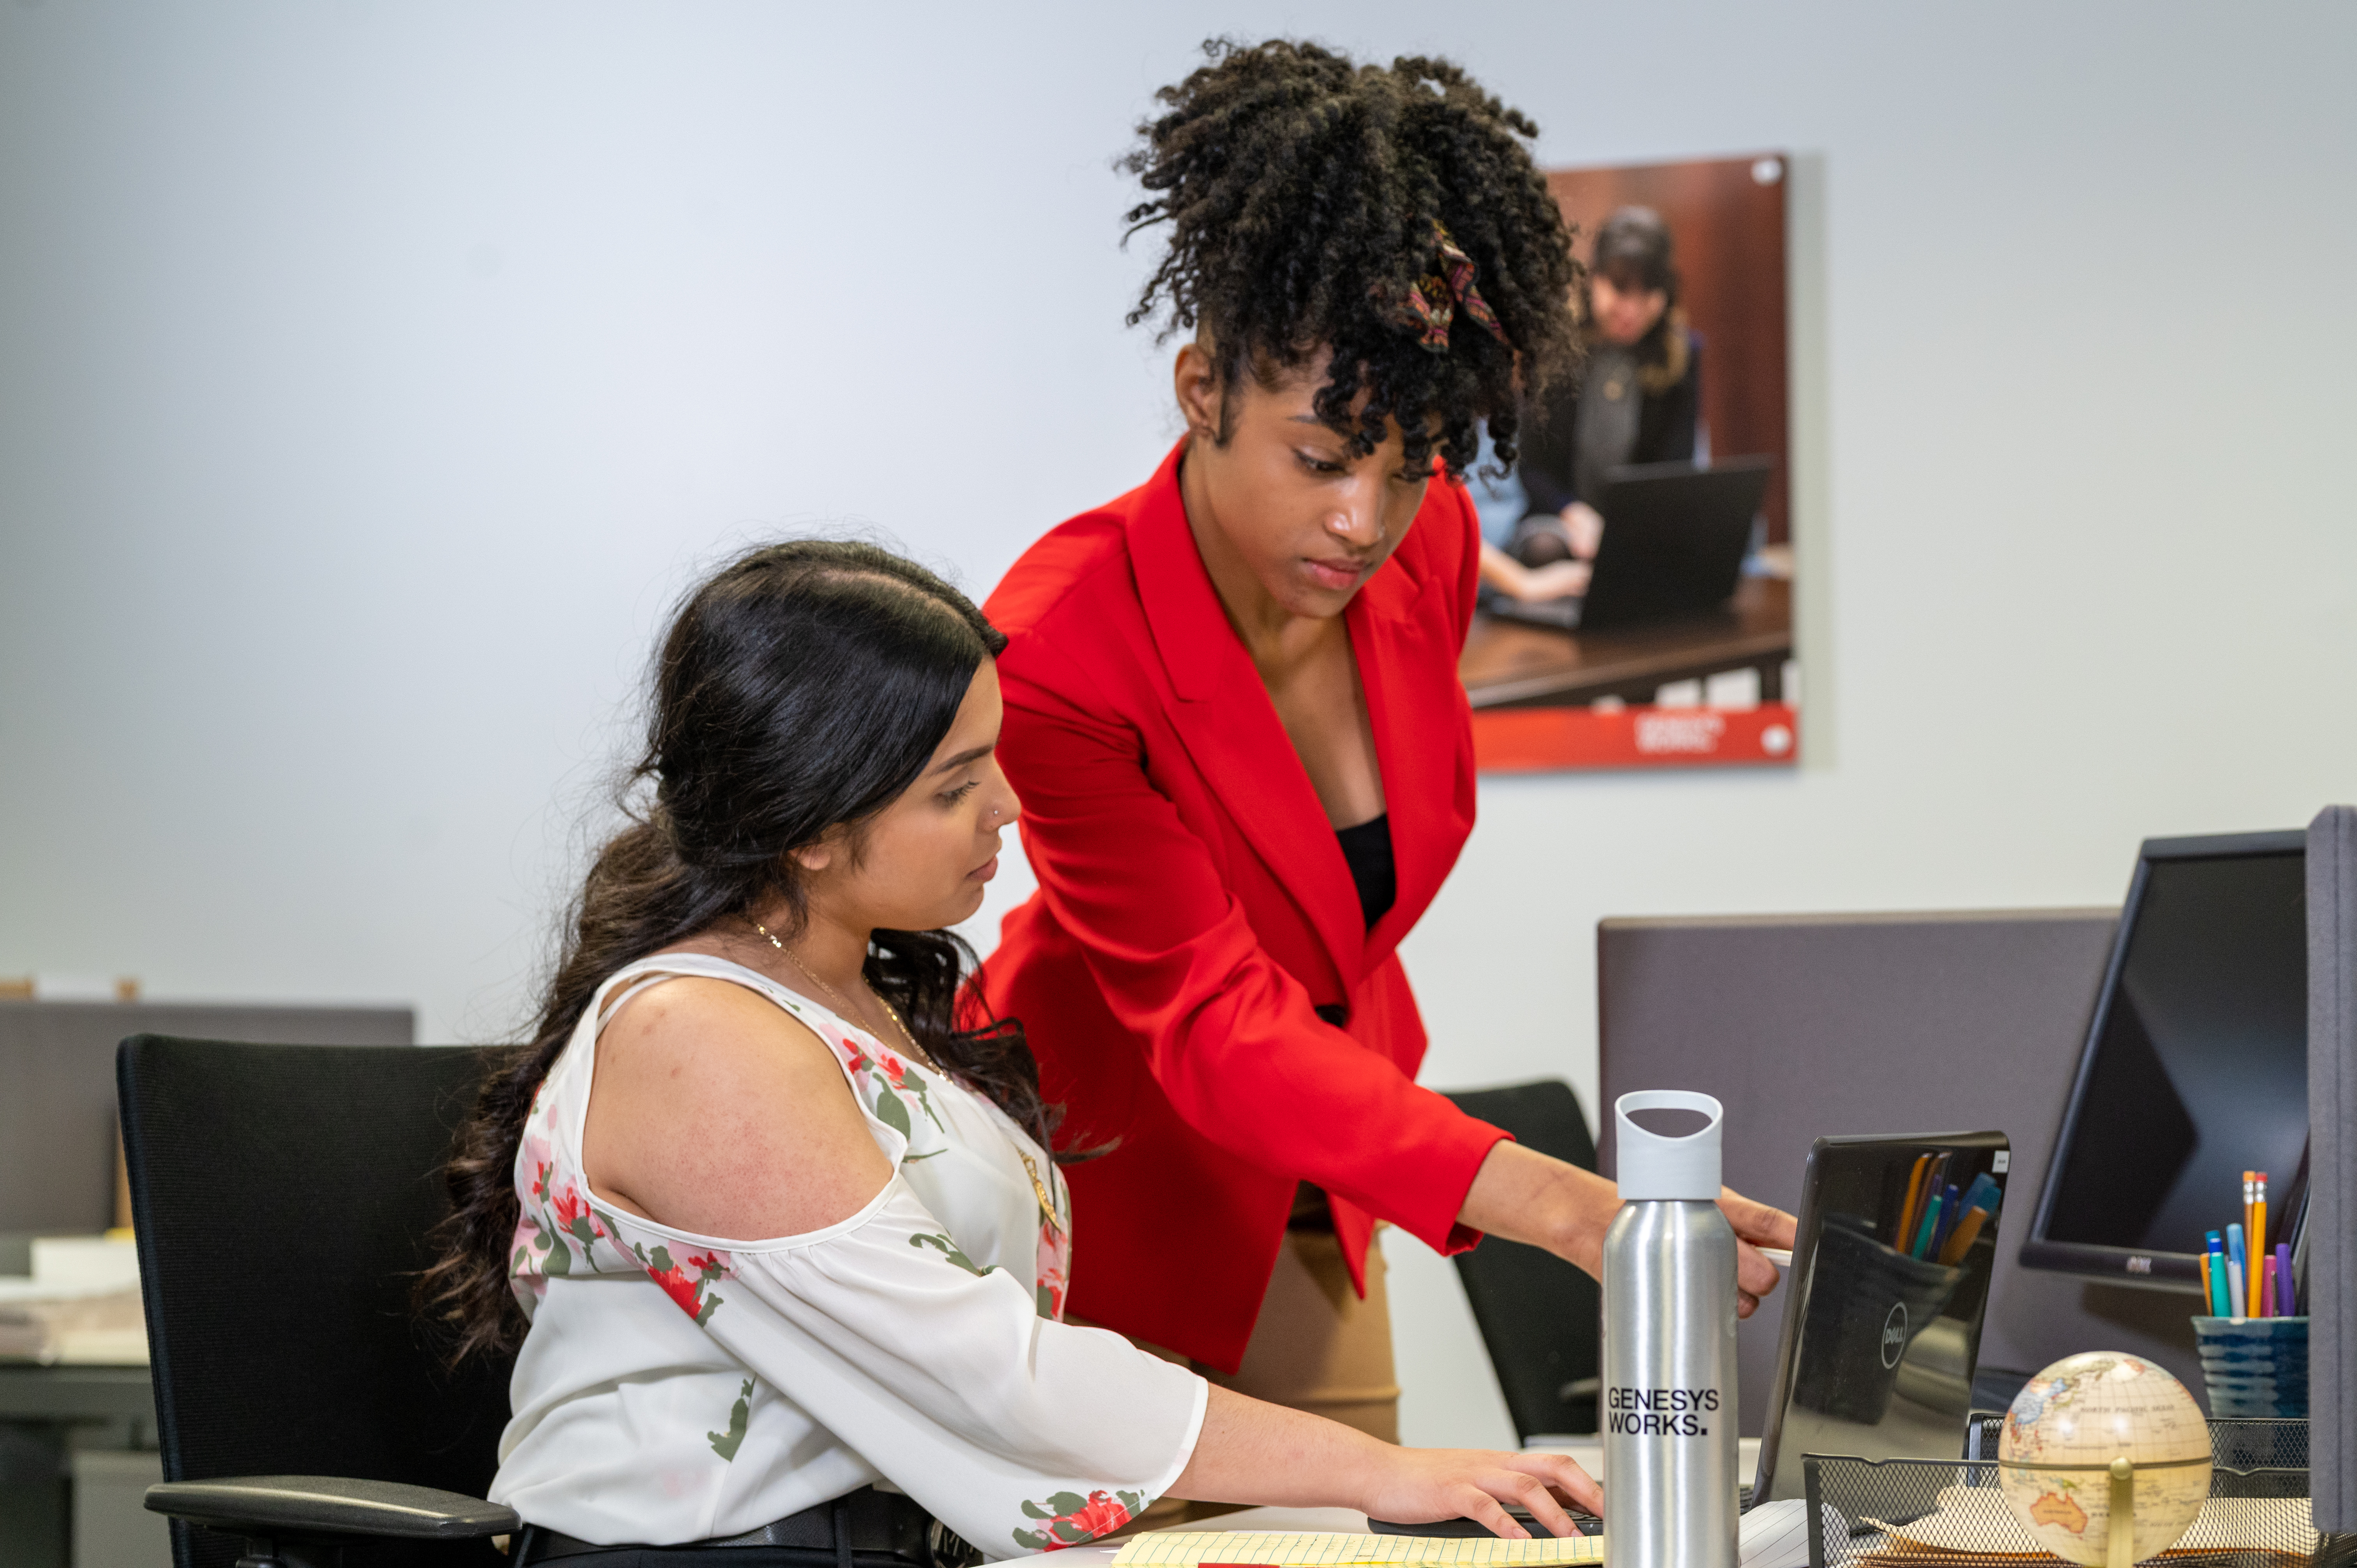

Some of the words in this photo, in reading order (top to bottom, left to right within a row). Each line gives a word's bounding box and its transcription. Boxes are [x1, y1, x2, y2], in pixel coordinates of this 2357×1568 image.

[1885, 1327, 1903, 1345] DELL
[1609, 1387, 1719, 1411] GENESYS
[1609, 1411, 1707, 1436] WORKS.
